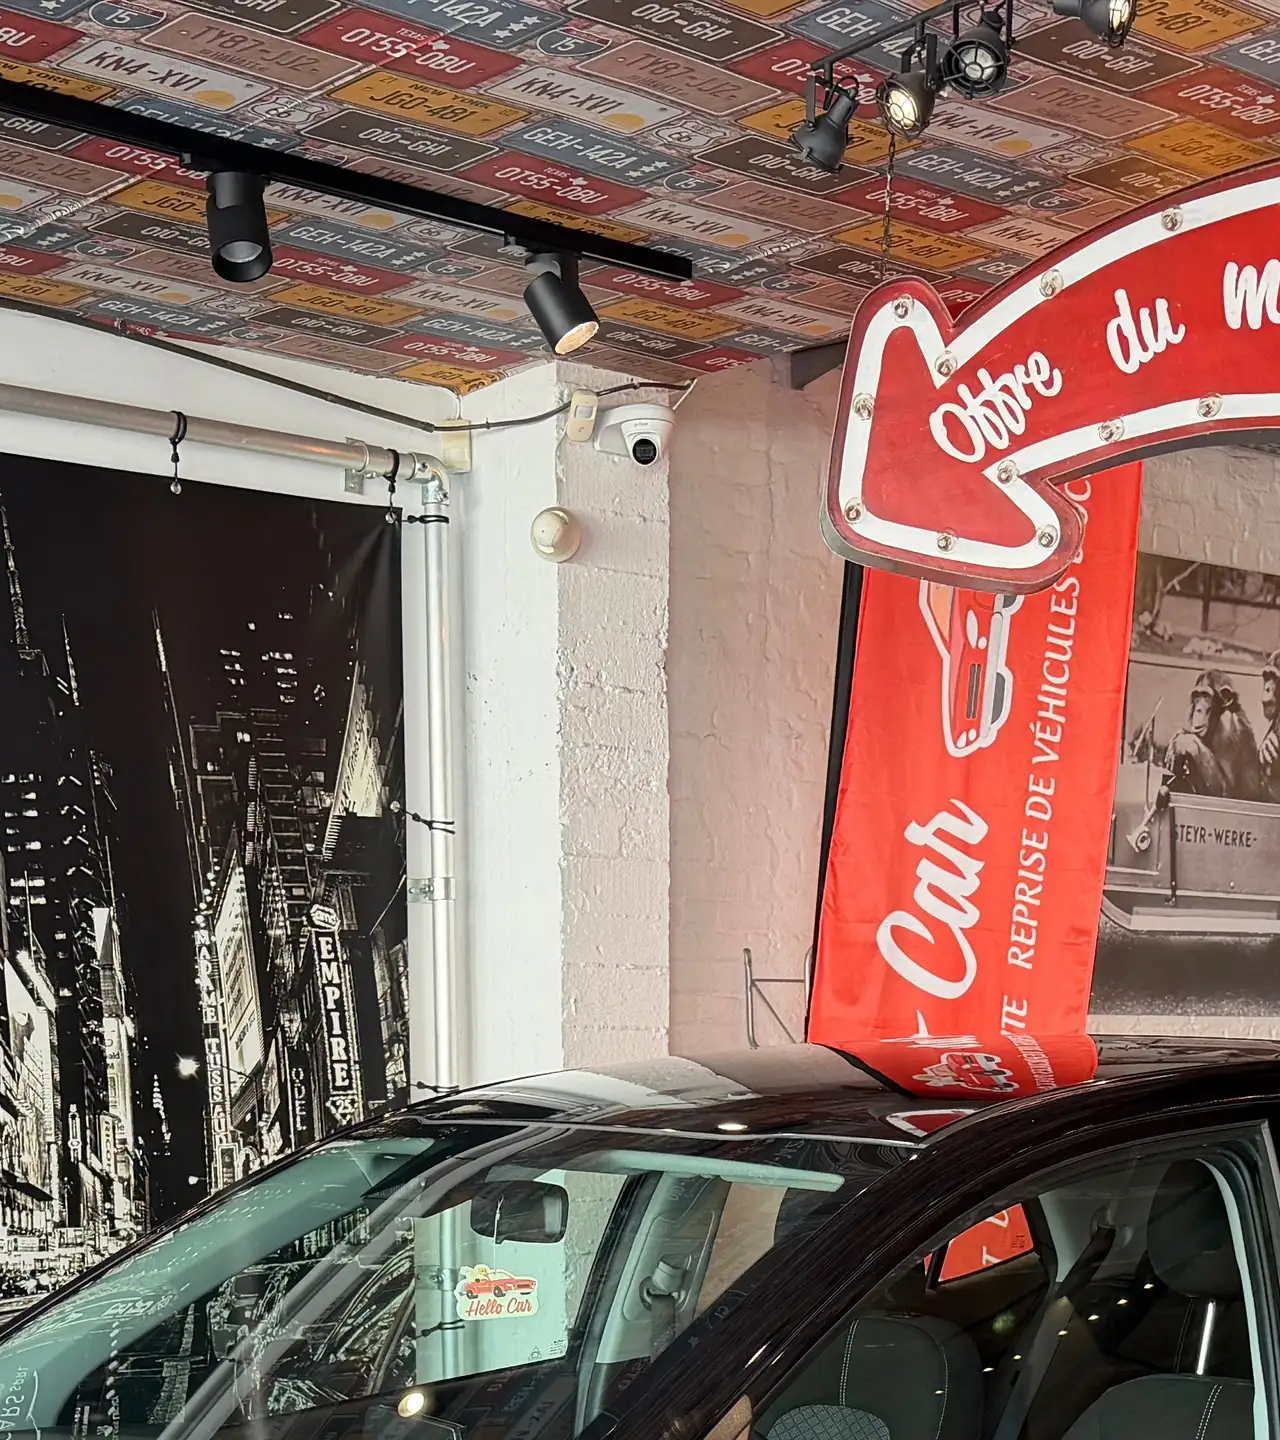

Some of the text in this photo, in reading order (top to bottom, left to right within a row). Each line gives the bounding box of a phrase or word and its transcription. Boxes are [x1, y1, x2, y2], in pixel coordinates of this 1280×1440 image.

[106, 9, 132, 25] 15
[395, 27, 427, 42] TEXAS
[549, 37, 578, 52] 15
[522, 127, 639, 170] GEH-142A
[674, 177, 698, 190] 15
[908, 154, 1013, 191] GEH-142A
[289, 226, 397, 261] GEH-142A
[98, 299, 199, 328] GEH-142A
[423, 319, 518, 343] GEH-142A
[928, 351, 1063, 465] Offre
[1106, 288, 1187, 376] du
[1031, 574, 1081, 764] VÉHICULES
[1025, 775, 1057, 824] DE
[875, 798, 990, 1001] Car
[1006, 831, 1049, 971] REPRISE
[194, 928, 220, 1025] MADAME
[317, 934, 351, 1090] EMPIRE
[465, 1296, 533, 1317] Hello Car
